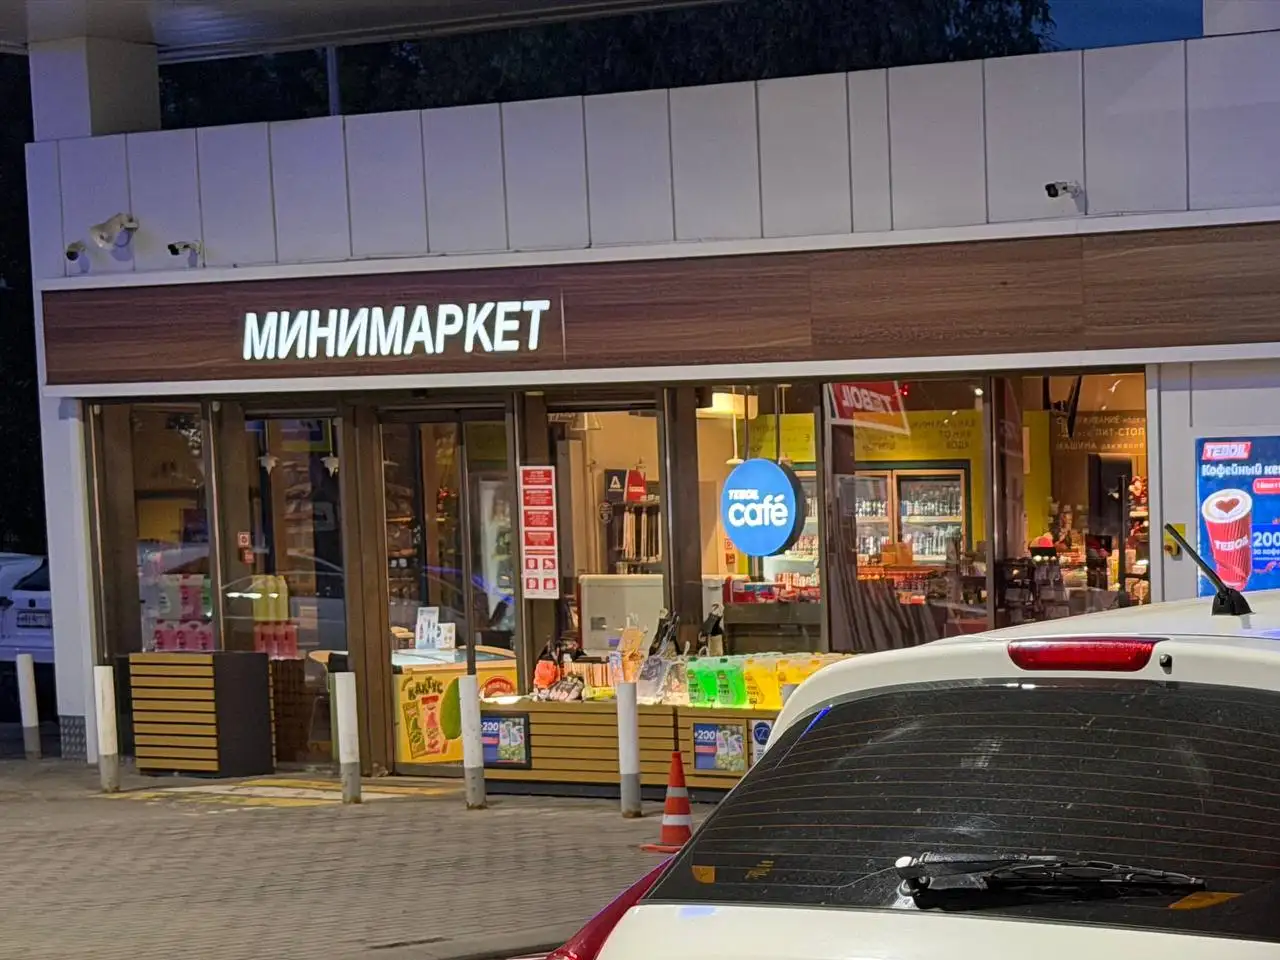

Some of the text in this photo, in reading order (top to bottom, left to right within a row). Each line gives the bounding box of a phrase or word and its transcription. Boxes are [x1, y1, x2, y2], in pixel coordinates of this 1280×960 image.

[243, 300, 550, 360] МИНИМАРКЕТ
[1202, 463, 1262, 478] Кофейный
[728, 494, 788, 527] café
